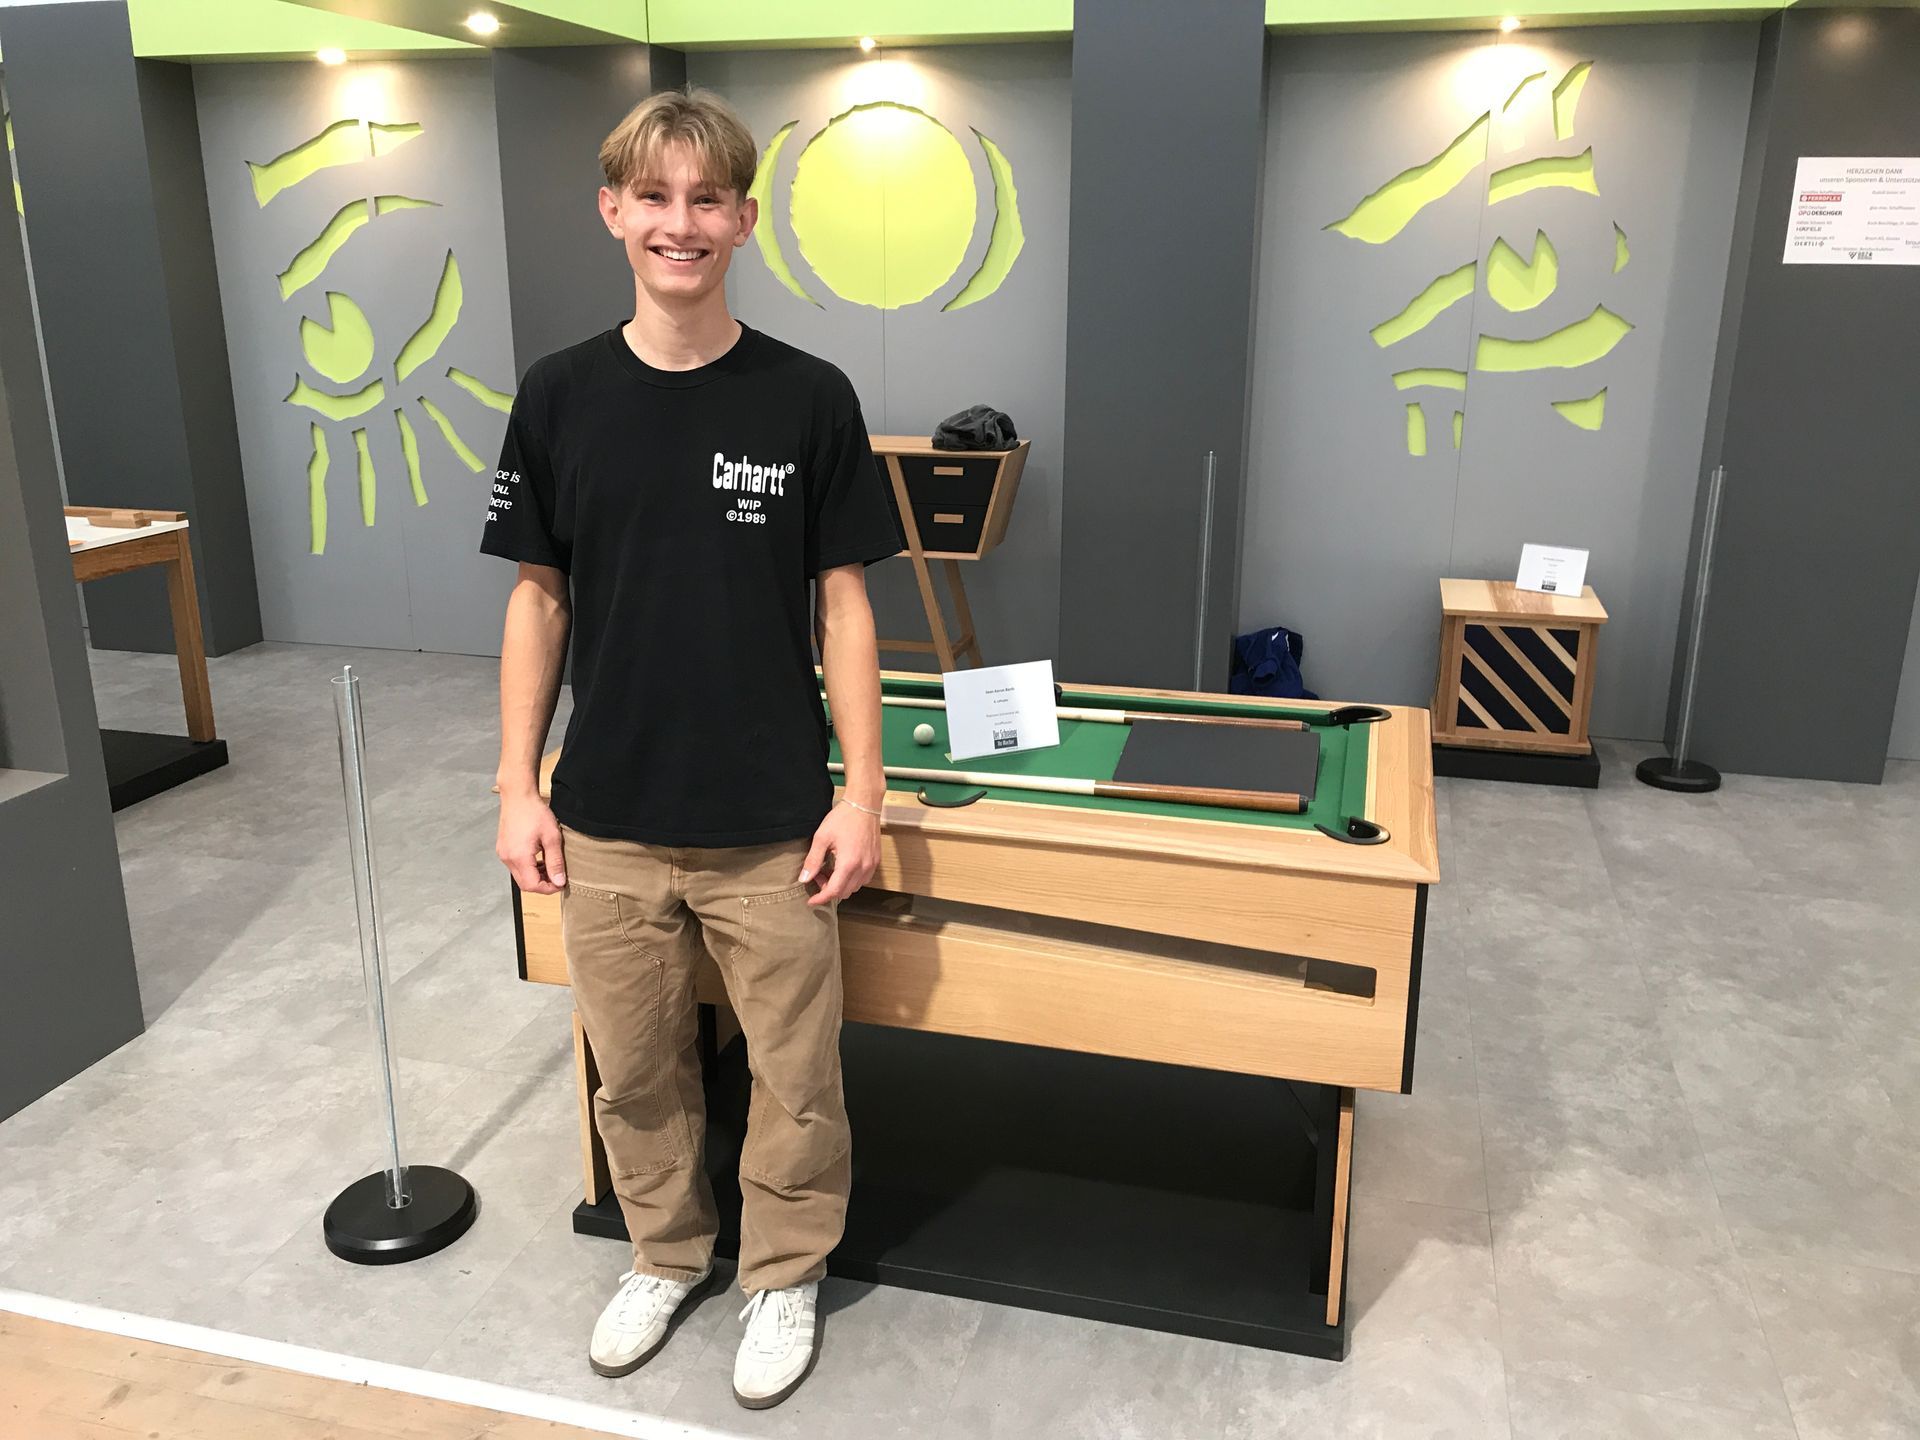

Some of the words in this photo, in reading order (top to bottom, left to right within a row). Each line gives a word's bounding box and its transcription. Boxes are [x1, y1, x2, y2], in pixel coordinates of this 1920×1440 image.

[1846, 167, 1884, 175] HERZLICHEN
[1885, 167, 1903, 175] DANK
[509, 471, 521, 483] is
[737, 498, 762, 511] WIP
[726, 509, 767, 525] ©1989
